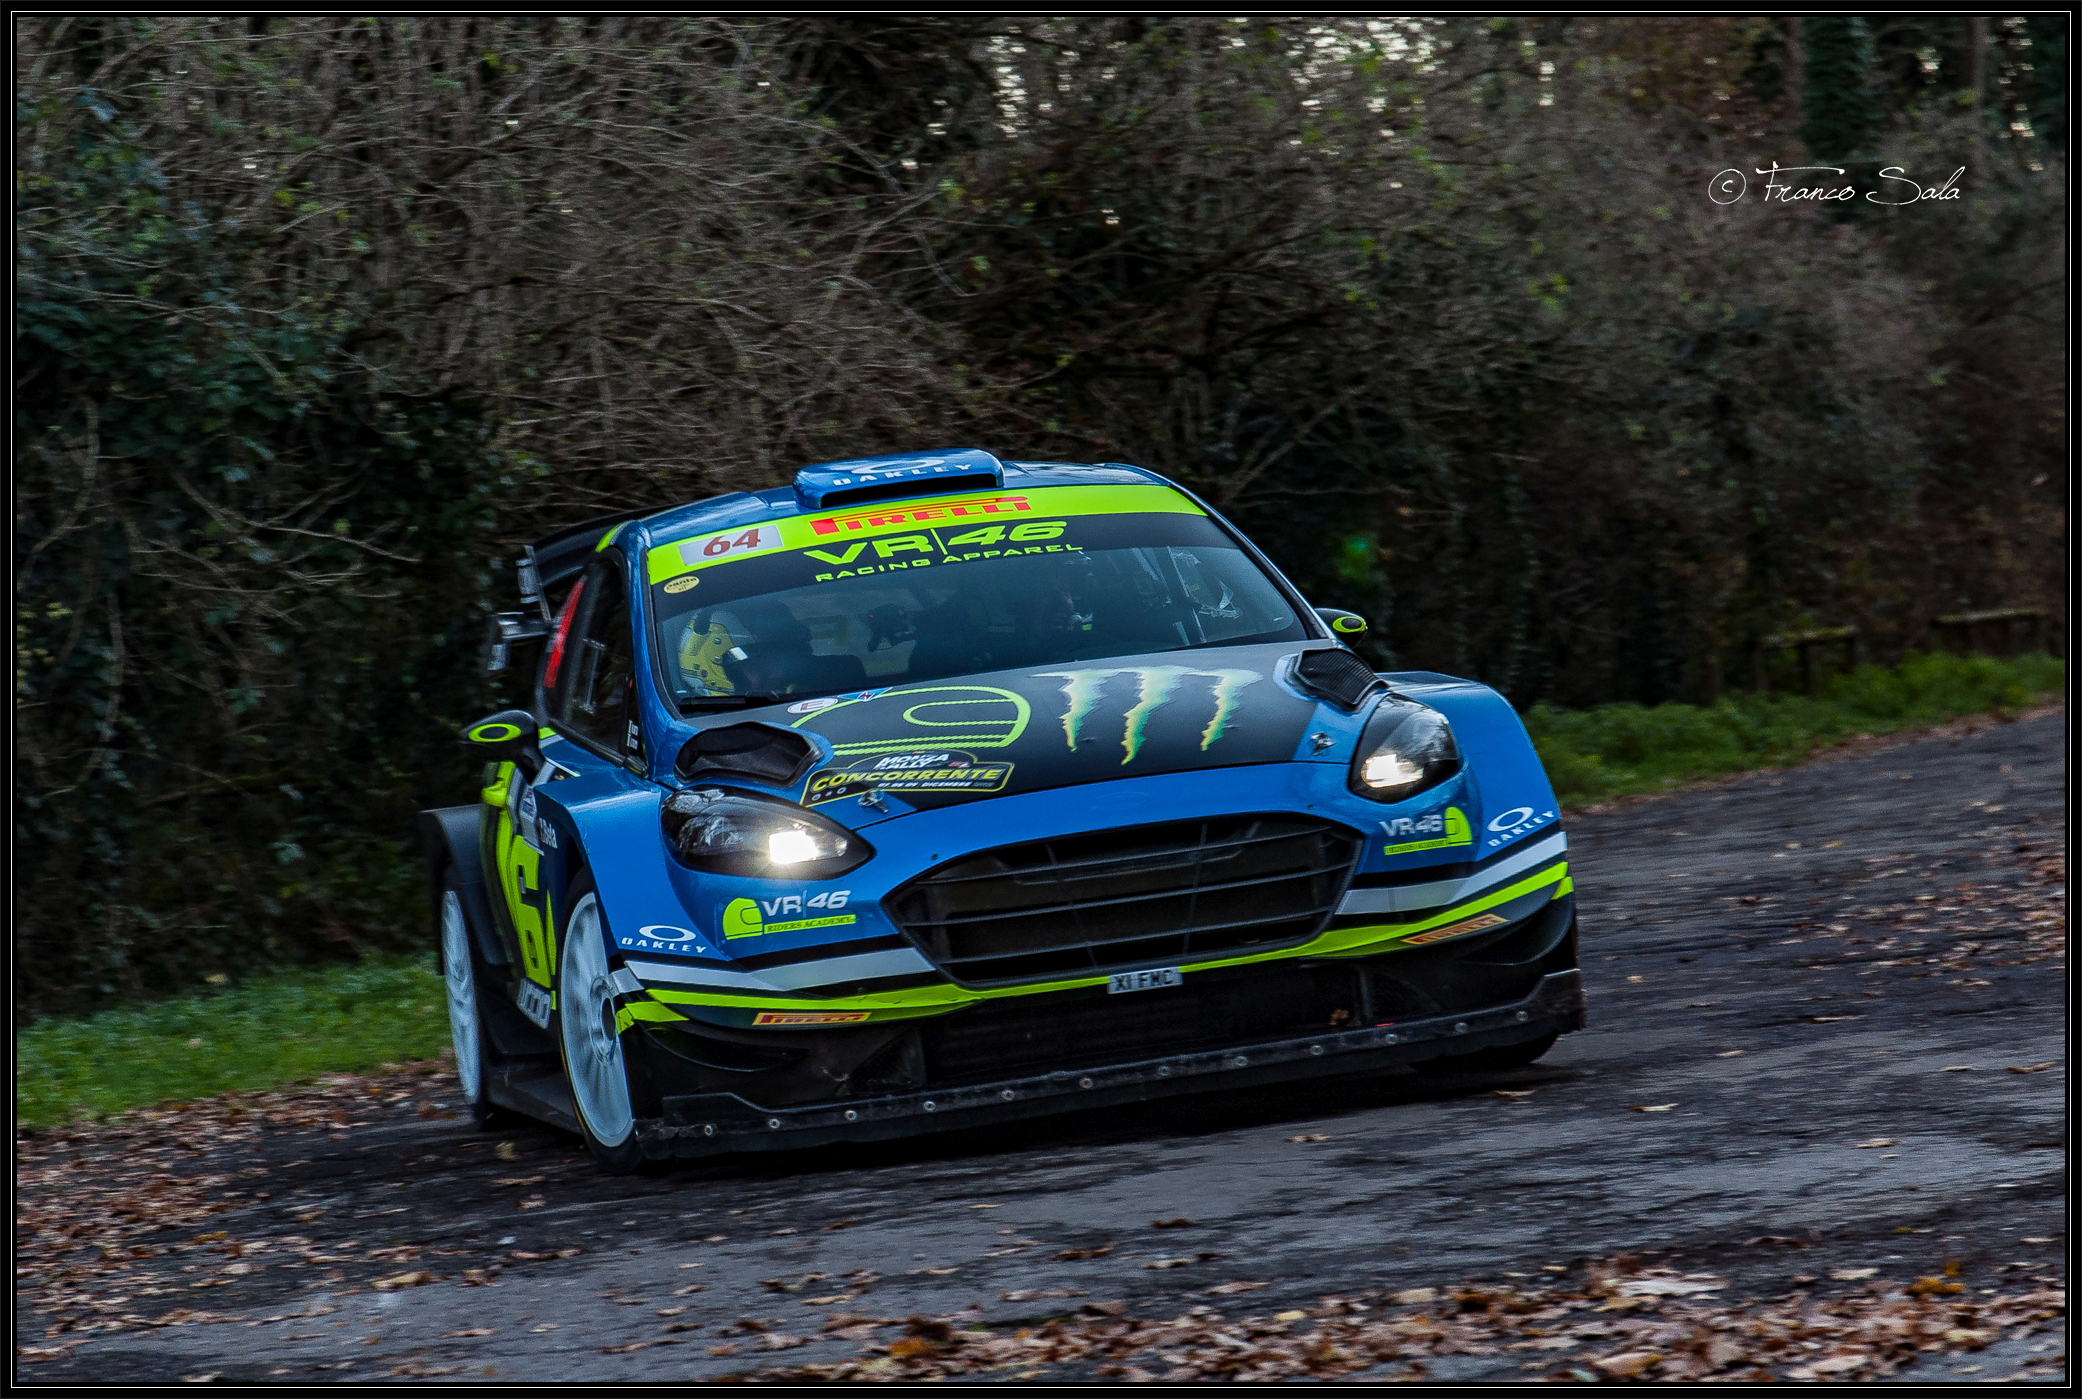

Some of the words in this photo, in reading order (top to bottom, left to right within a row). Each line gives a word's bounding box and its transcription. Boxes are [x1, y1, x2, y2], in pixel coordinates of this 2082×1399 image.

[832, 463, 972, 486] OAKLEY
[809, 496, 1032, 537] PIRELLI
[703, 528, 761, 557] 64
[815, 557, 932, 582] RACING
[942, 543, 1084, 564] APPAREL
[872, 759, 934, 770] RALLY
[879, 753, 950, 766] MONZA
[811, 768, 1007, 792] CONCORRENTE
[1487, 810, 1556, 847] OAKLEY
[766, 920, 803, 933] RIDERS
[621, 937, 707, 954] OAKLEY
[1138, 969, 1174, 989] FMC
